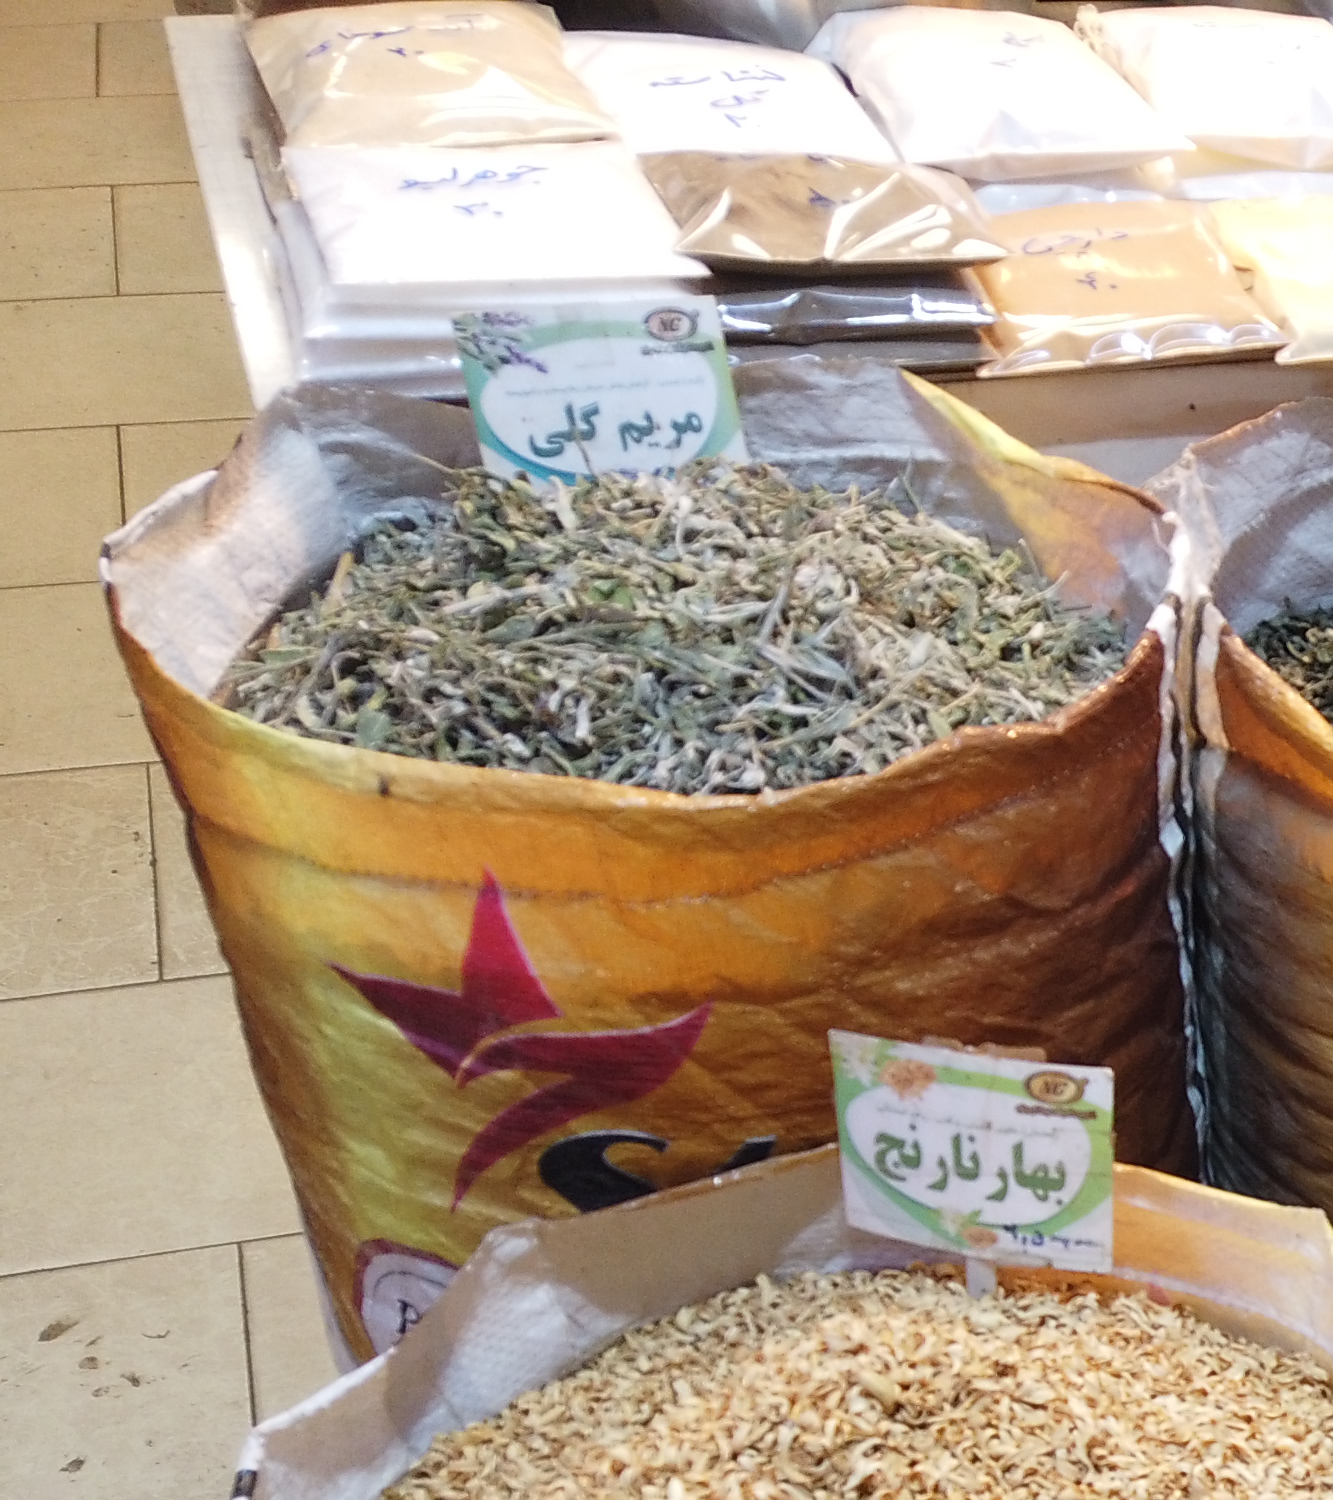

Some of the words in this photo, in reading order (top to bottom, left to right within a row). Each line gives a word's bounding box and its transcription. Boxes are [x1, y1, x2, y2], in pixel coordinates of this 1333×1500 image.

[528, 401, 600, 459] گلی
[617, 410, 703, 453] مریم
[872, 1122, 981, 1193] نارنج
[984, 1140, 1067, 1206] بهار
